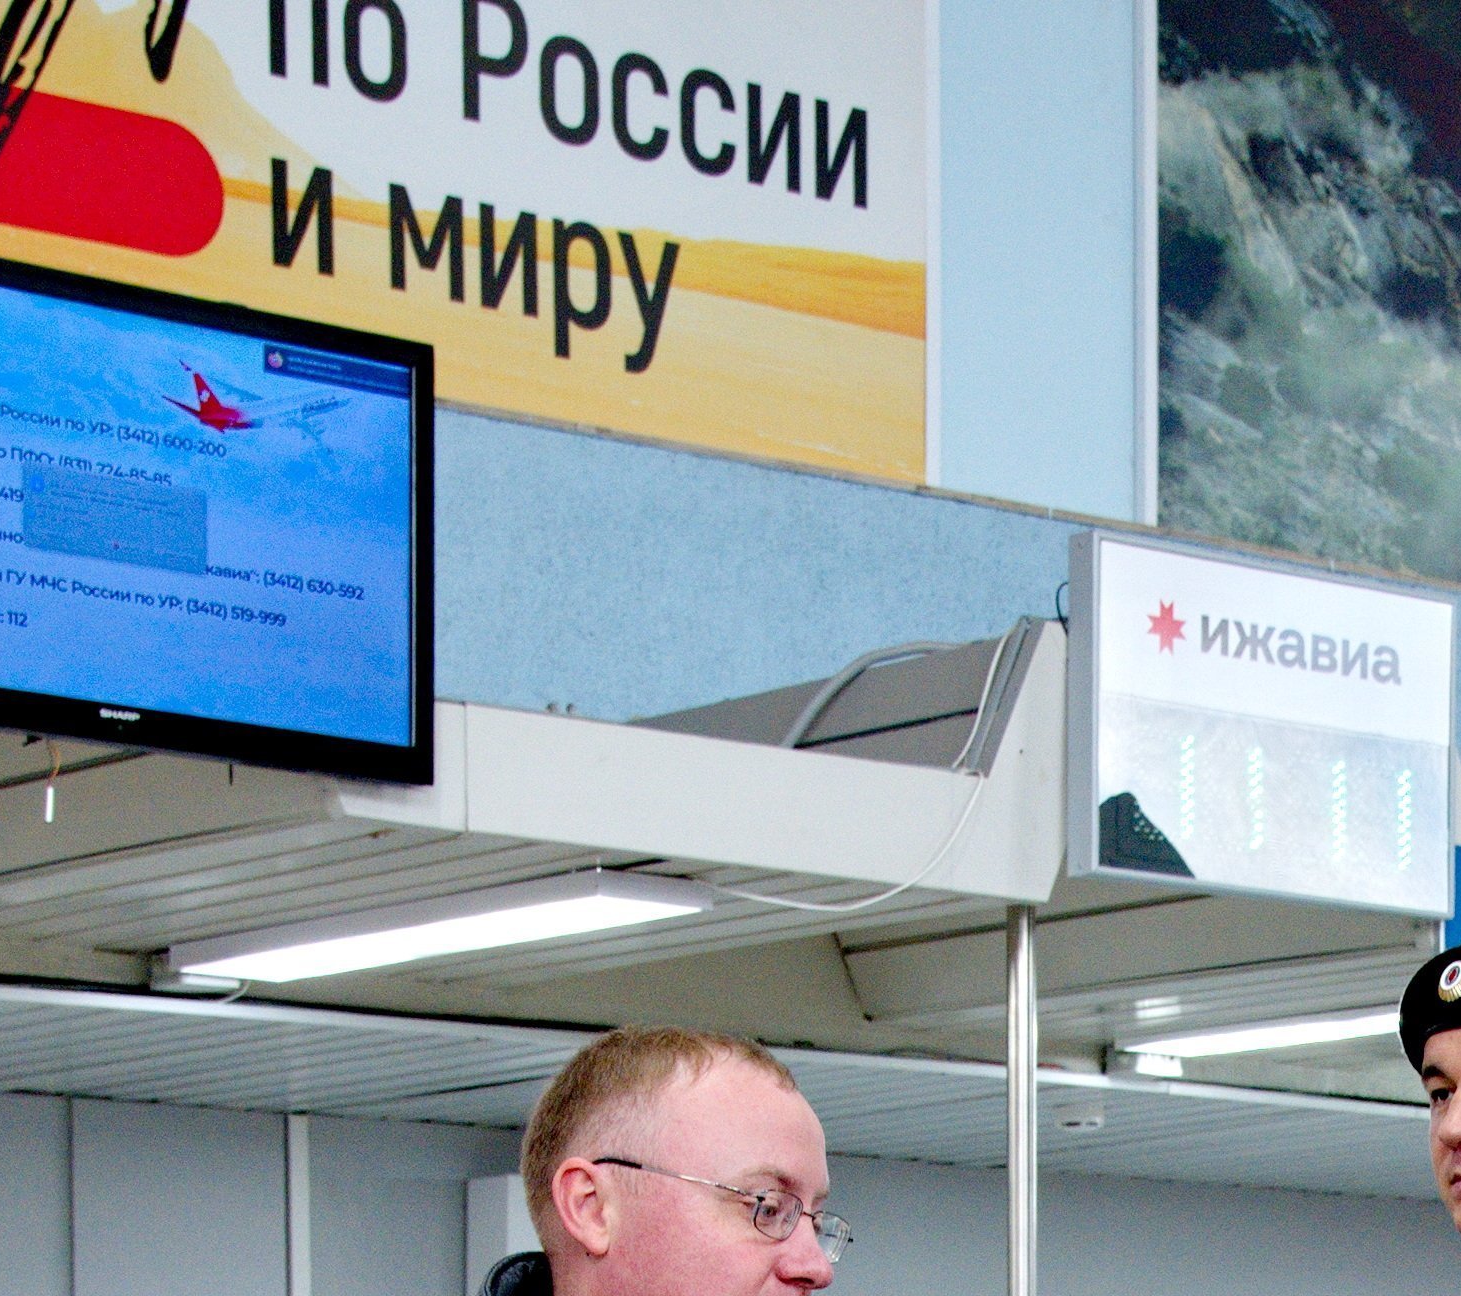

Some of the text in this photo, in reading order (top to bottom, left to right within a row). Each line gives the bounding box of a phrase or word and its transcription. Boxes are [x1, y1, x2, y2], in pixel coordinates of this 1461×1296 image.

[268, 0, 407, 102] по
[462, 0, 869, 210] России
[270, 156, 682, 374] и миру
[1, 403, 61, 430] России
[64, 417, 86, 433] по
[117, 425, 160, 449] (3412)
[163, 433, 227, 458] 600-200
[6, 568, 27, 587] ГУ
[30, 572, 68, 594] МЧС
[72, 580, 132, 603] России
[135, 591, 155, 607] по
[186, 600, 227, 623] (3412)
[230, 605, 287, 628] 519-999
[263, 569, 304, 593] (3412)
[307, 577, 365, 601] 630-592
[7, 608, 29, 628] 112
[1200, 613, 1402, 687] ижавиа
